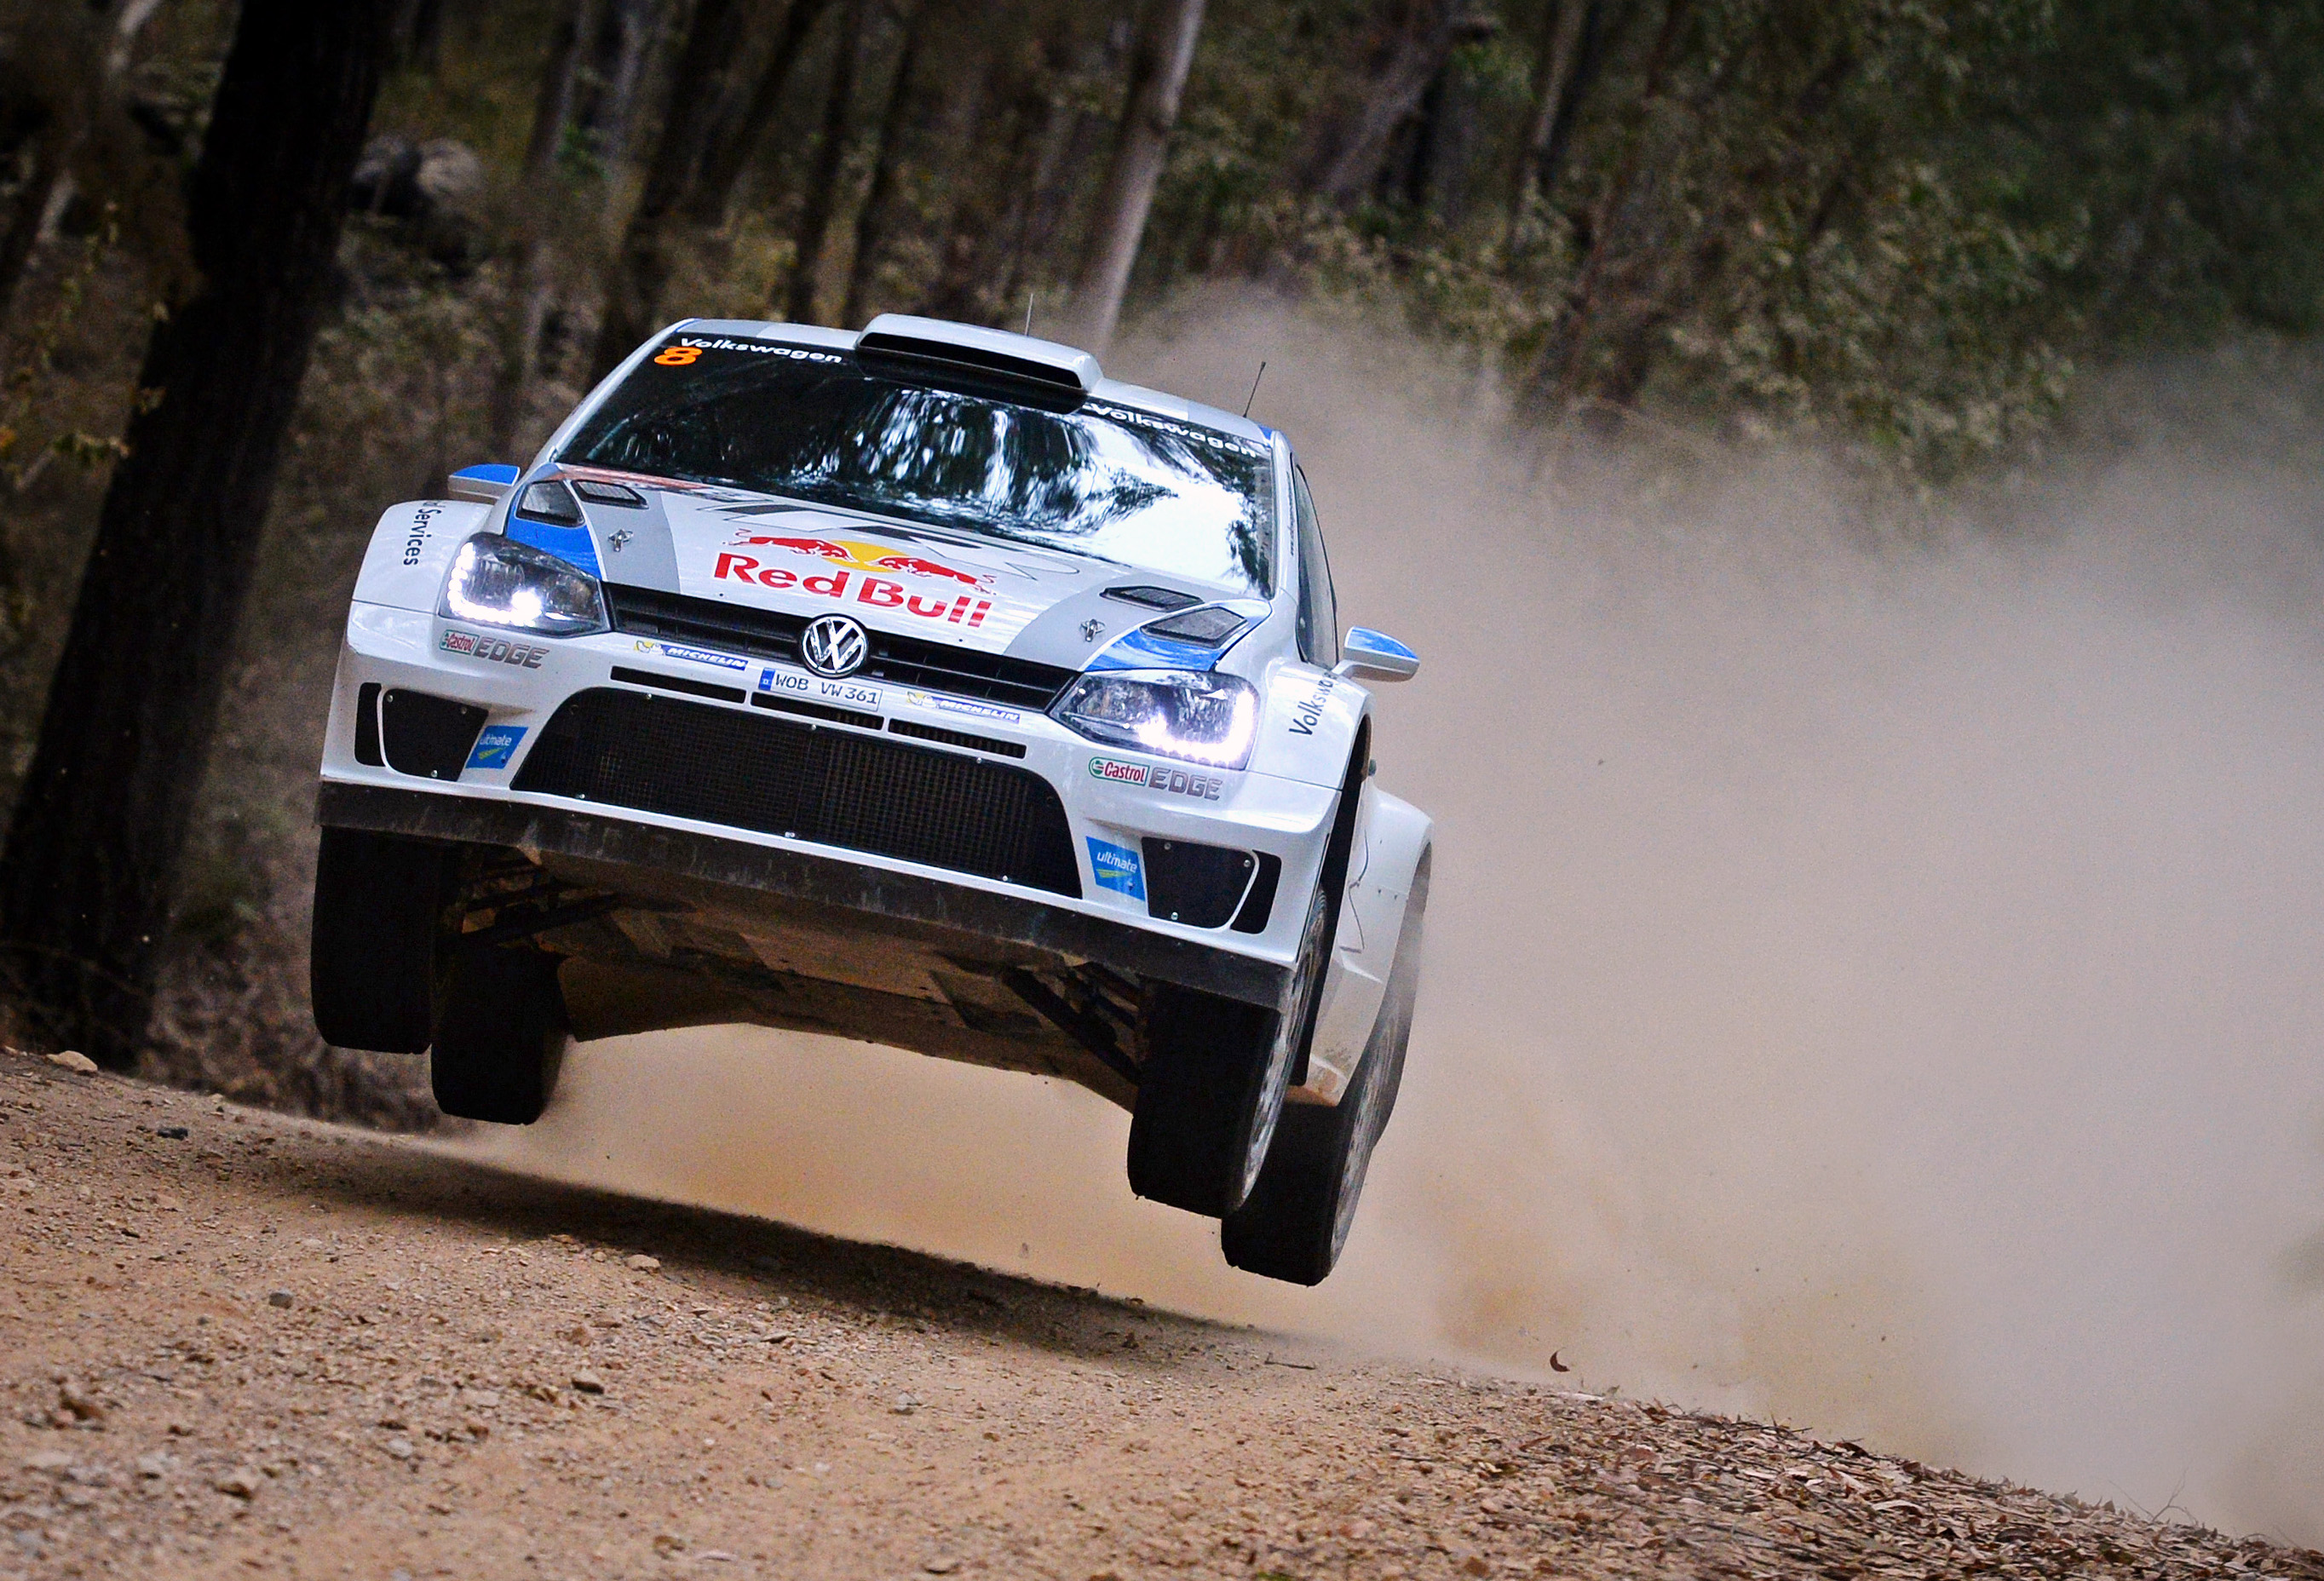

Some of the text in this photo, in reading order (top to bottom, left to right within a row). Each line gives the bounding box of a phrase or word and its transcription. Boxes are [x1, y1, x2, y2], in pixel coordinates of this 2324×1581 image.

[653, 346, 703, 365] 8
[682, 337, 843, 363] Volkswagen
[1090, 402, 1257, 457] Volkswagen
[403, 509, 442, 566] Services
[714, 552, 992, 628] Red Bull
[473, 636, 549, 669] EDGE
[668, 647, 747, 668] MICHELIN
[775, 673, 809, 691] WOB
[820, 681, 843, 697] VW
[844, 687, 877, 704] 361
[940, 700, 1018, 721] MICHELIN
[1104, 762, 1222, 801] Castrol EDGE
[1096, 851, 1137, 874] ultimate
